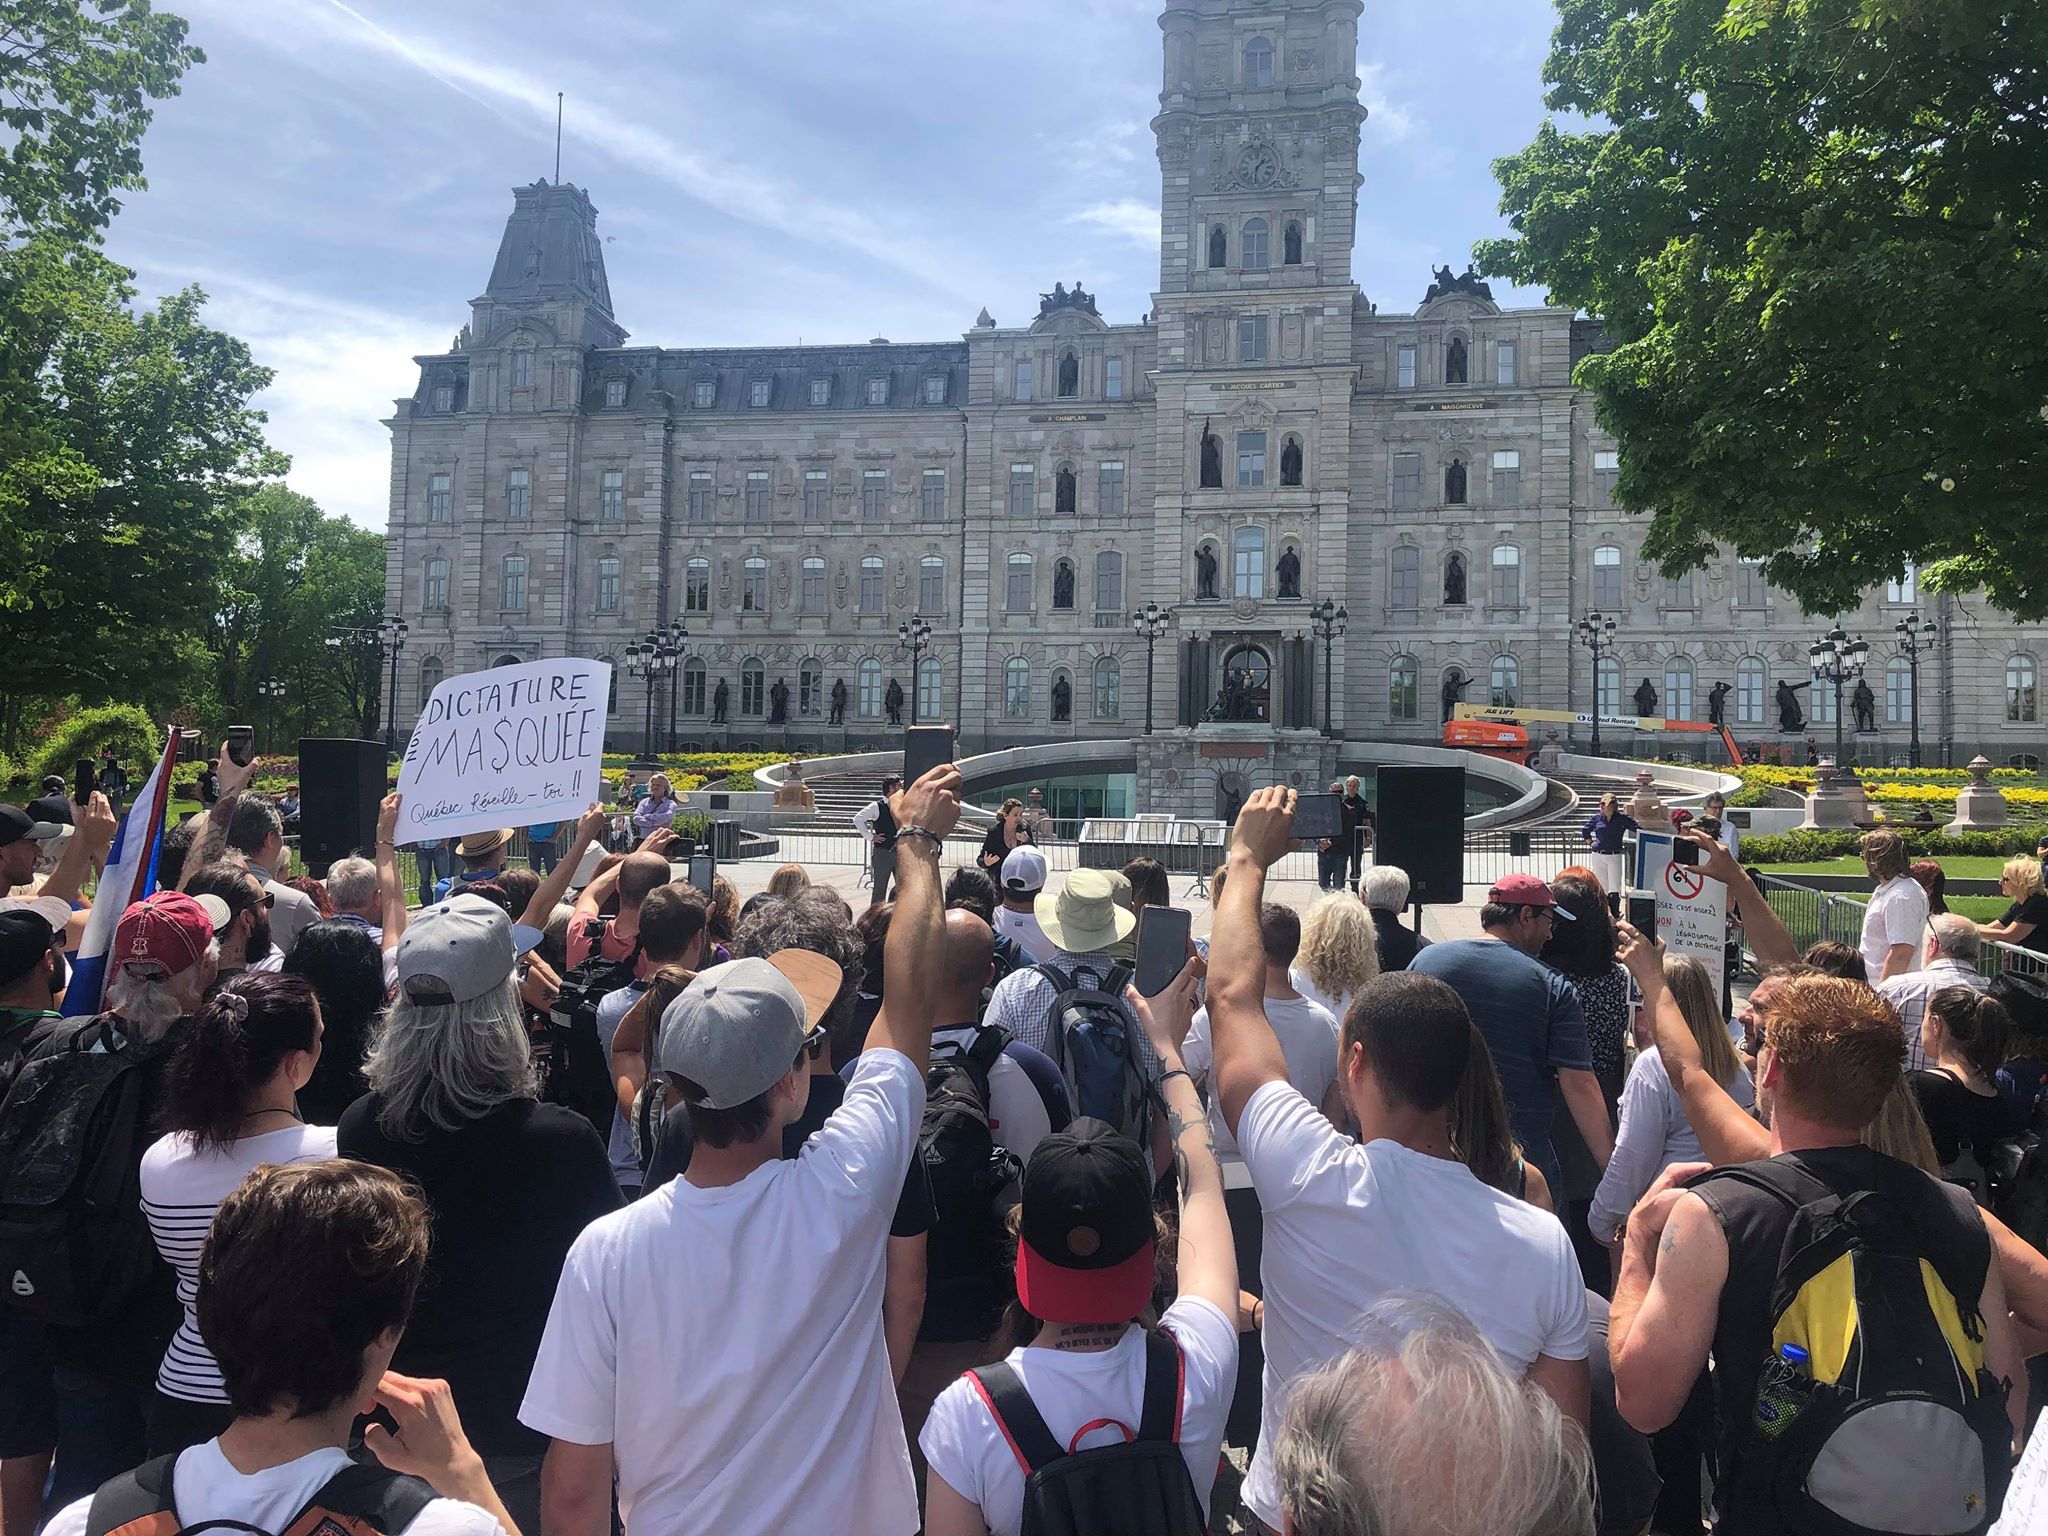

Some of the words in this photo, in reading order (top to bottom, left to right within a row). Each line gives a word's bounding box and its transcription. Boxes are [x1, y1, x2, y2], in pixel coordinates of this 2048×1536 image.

[428, 674, 590, 725] DICTATURE
[1610, 717, 1636, 725] Rentals
[410, 800, 464, 826] Québec
[1688, 921, 1697, 930] LA
[1675, 938, 1683, 946] DE
